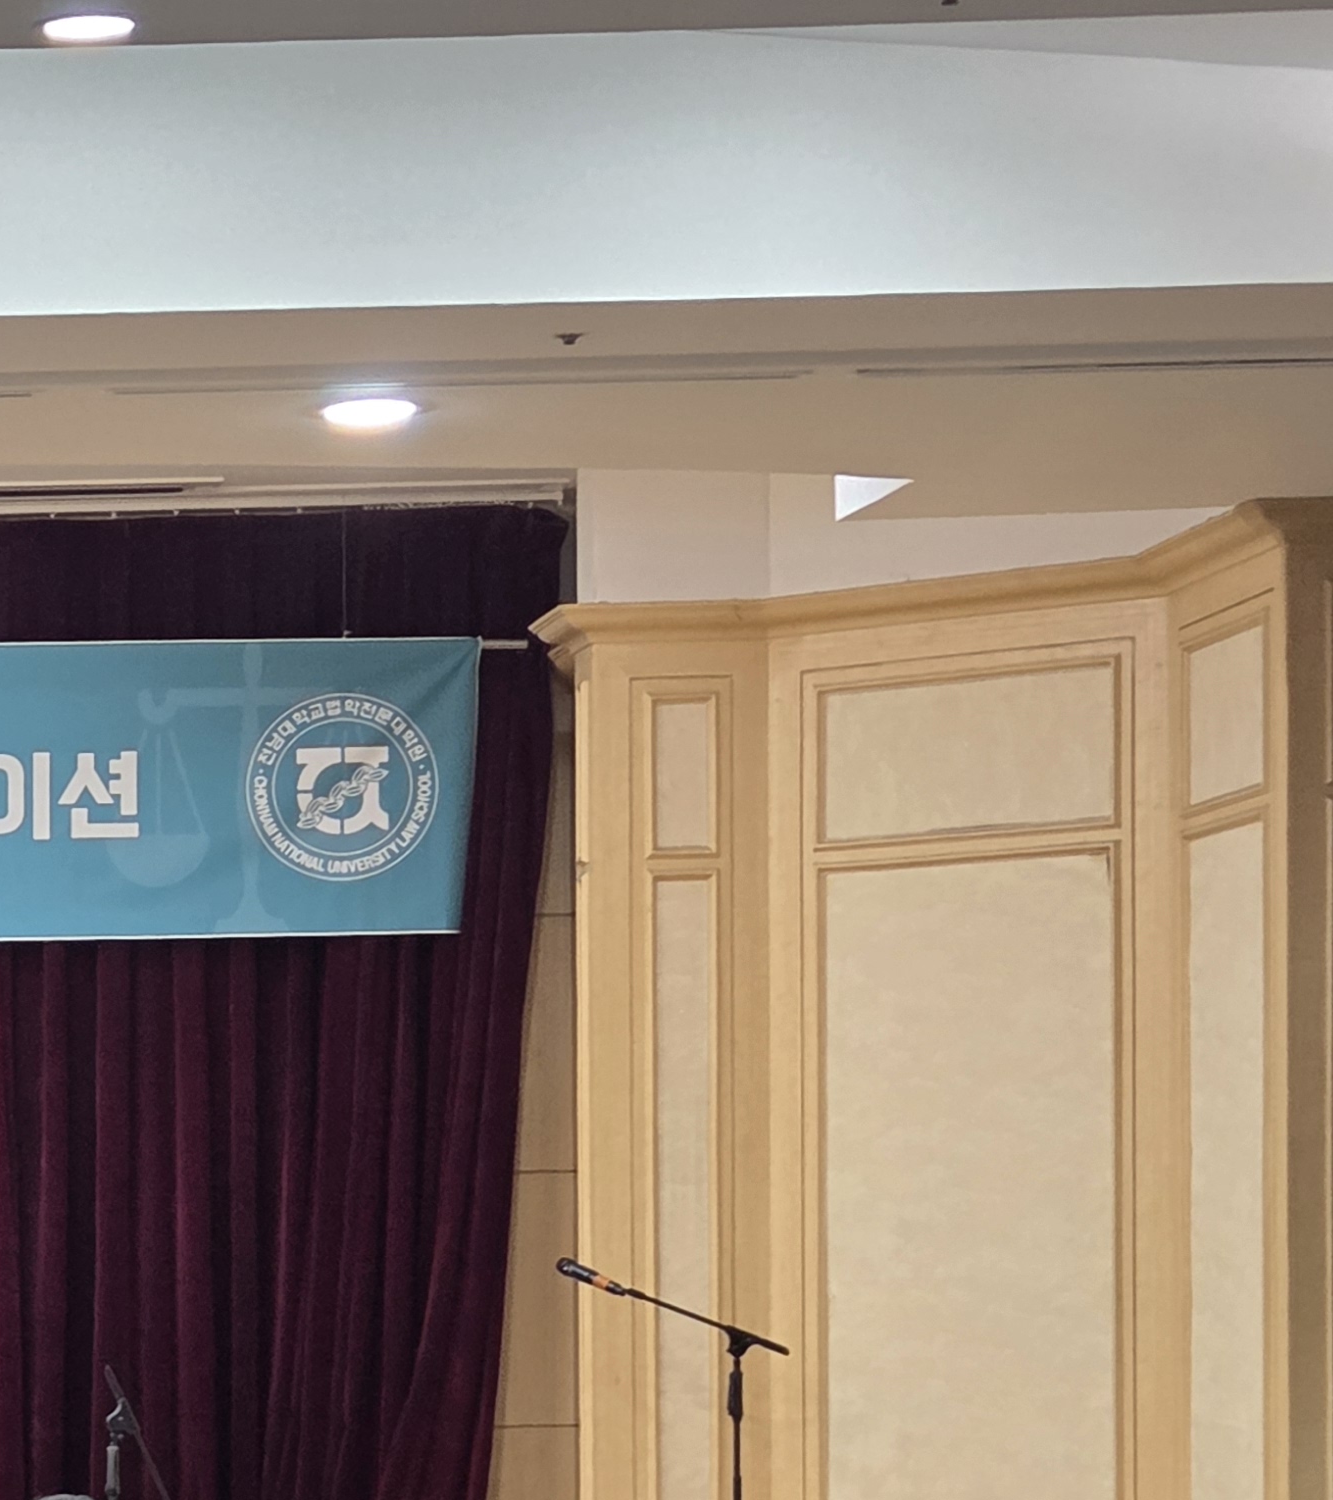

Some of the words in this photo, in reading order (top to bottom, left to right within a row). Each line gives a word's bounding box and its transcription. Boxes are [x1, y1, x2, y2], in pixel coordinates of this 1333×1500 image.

[271, 831, 325, 872] NATIONAL
[328, 847, 401, 874] UNIVERSITY
[396, 823, 422, 849] LAW
[413, 770, 432, 822] SCHOOL
